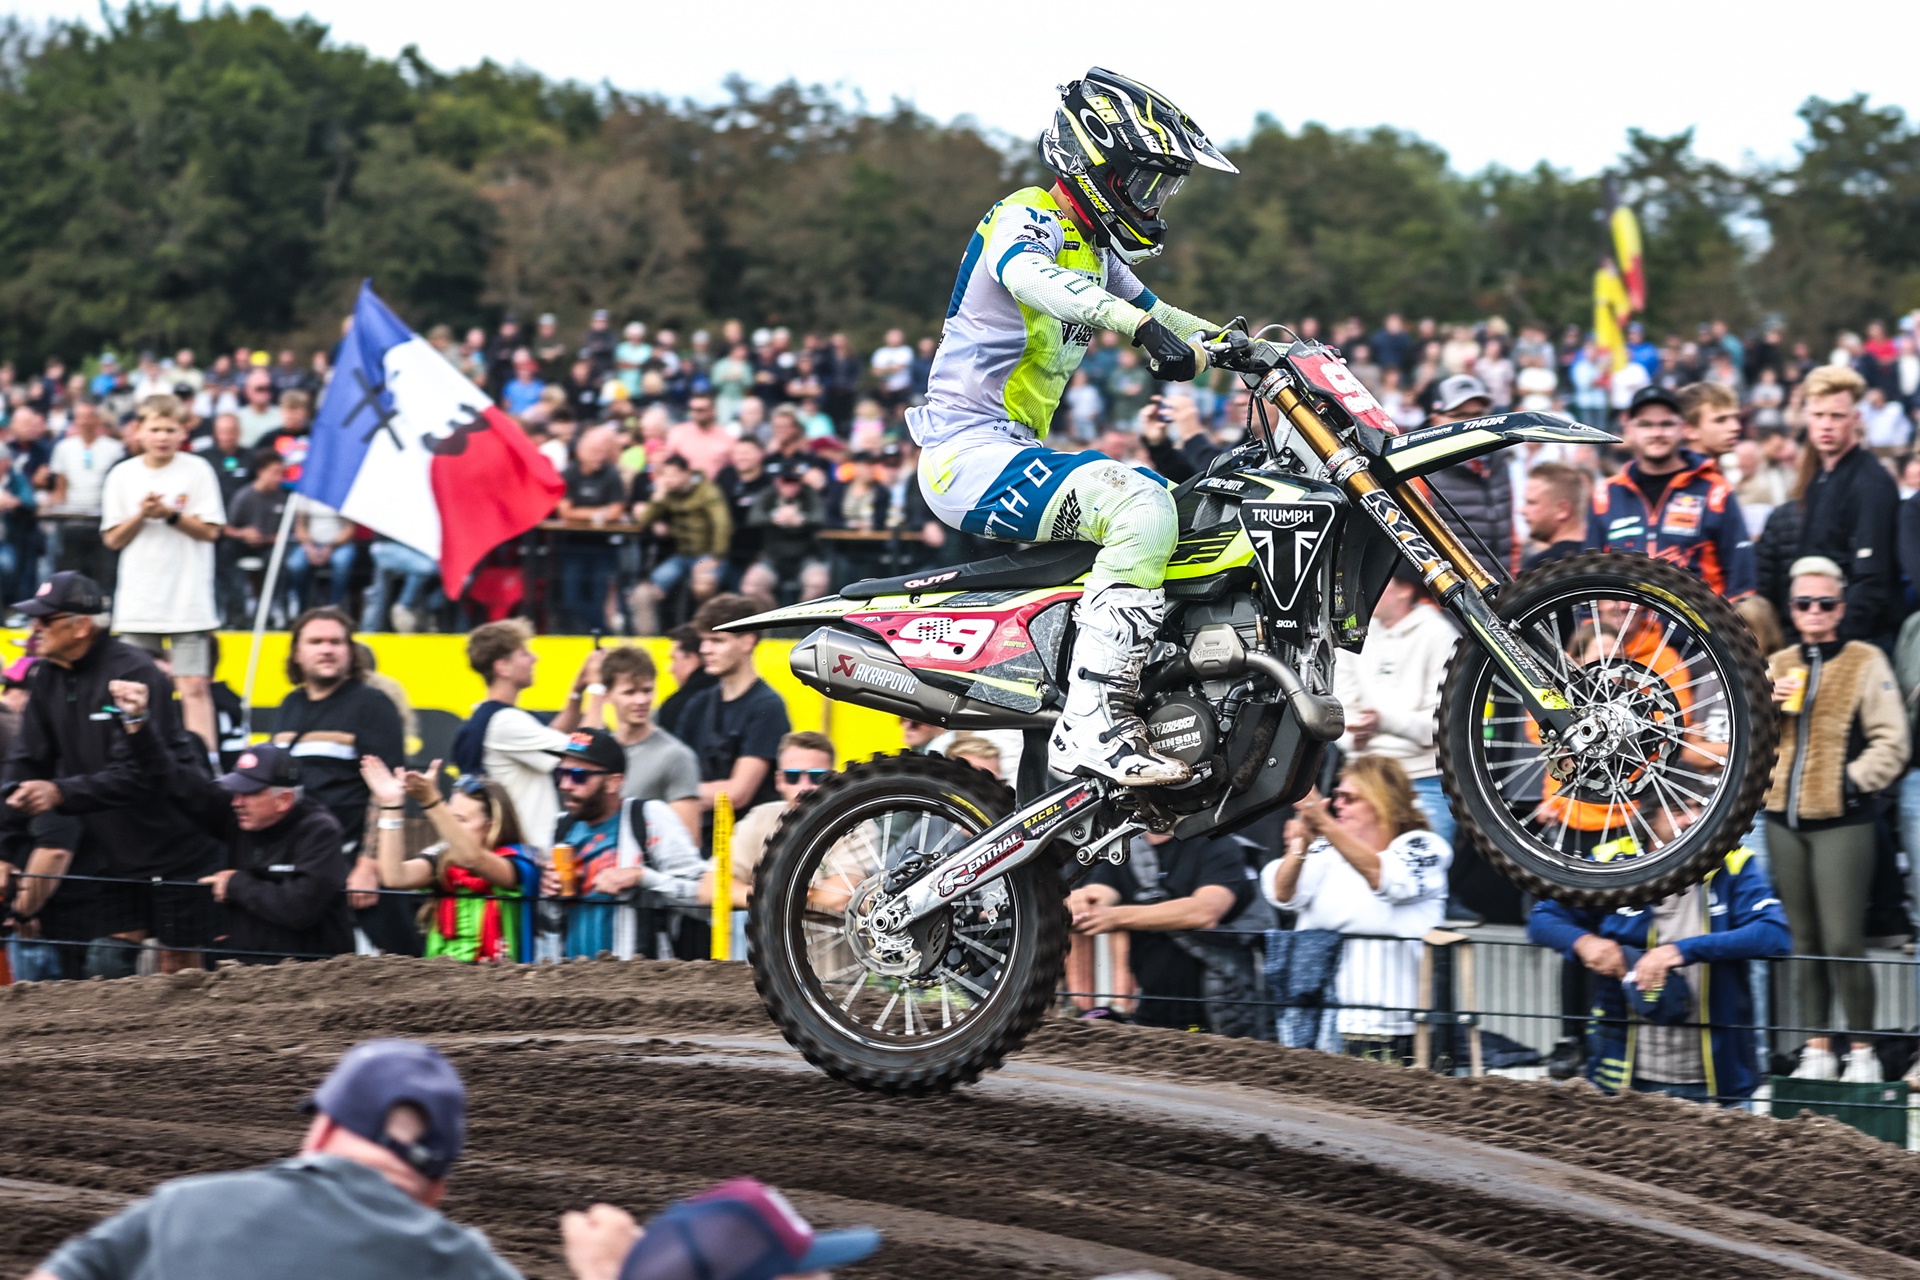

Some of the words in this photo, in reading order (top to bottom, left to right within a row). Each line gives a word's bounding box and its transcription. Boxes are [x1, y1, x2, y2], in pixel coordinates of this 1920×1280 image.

[1074, 174, 1109, 213] RACING
[1080, 172, 1115, 213] TRIUMPH
[1462, 415, 1508, 431] THOR
[1207, 477, 1222, 488] CALL
[1223, 481, 1245, 491] DUTY
[1051, 488, 1078, 540] TRIUMPH
[1252, 508, 1314, 526] TRIUMPH
[1362, 489, 1443, 563] KYB
[904, 571, 958, 588] GUTS
[1275, 620, 1298, 628] SKDA
[890, 617, 996, 662] 99
[854, 663, 919, 695] AKRAPOVIC
[1065, 789, 1089, 810] RK
[1023, 804, 1062, 829] EXCEL
